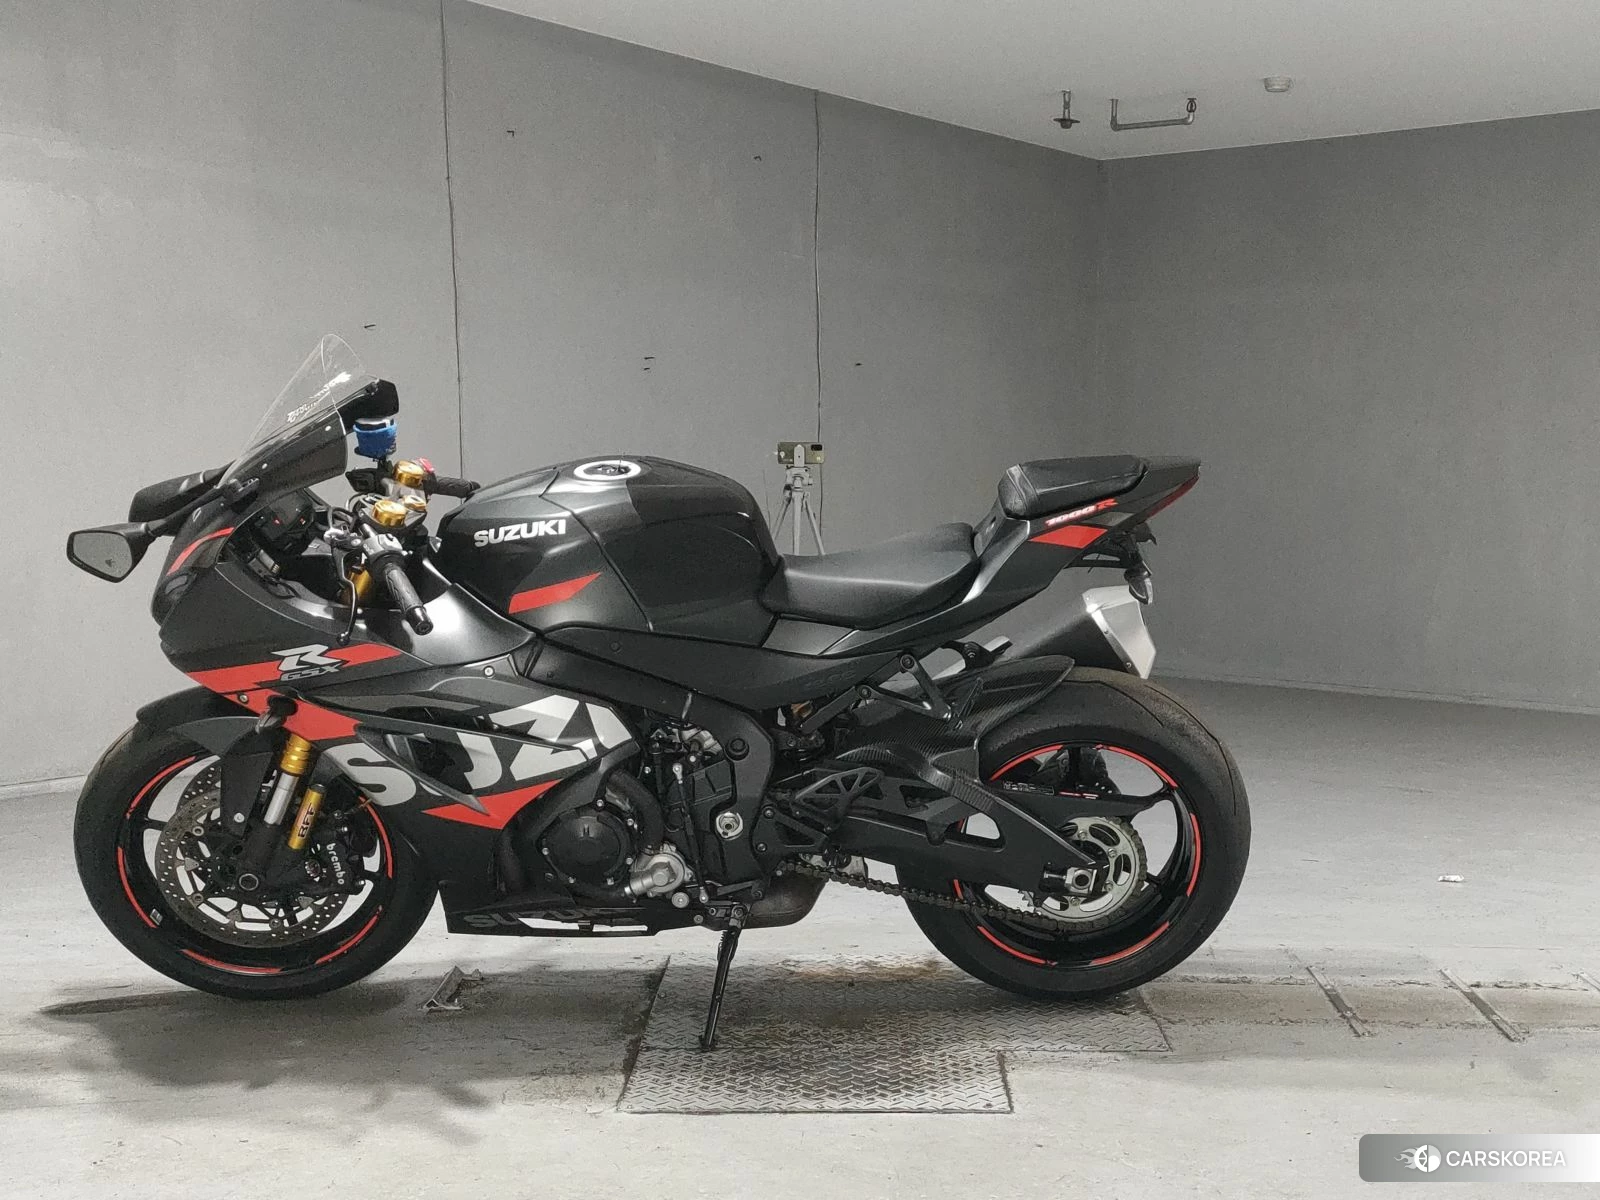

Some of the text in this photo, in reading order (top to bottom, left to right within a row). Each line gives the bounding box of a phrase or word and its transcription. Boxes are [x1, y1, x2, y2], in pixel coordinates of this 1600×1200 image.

[473, 519, 567, 548] SUZUKI
[270, 643, 342, 671] R
[280, 662, 344, 682] GSX
[326, 842, 346, 885] brembo
